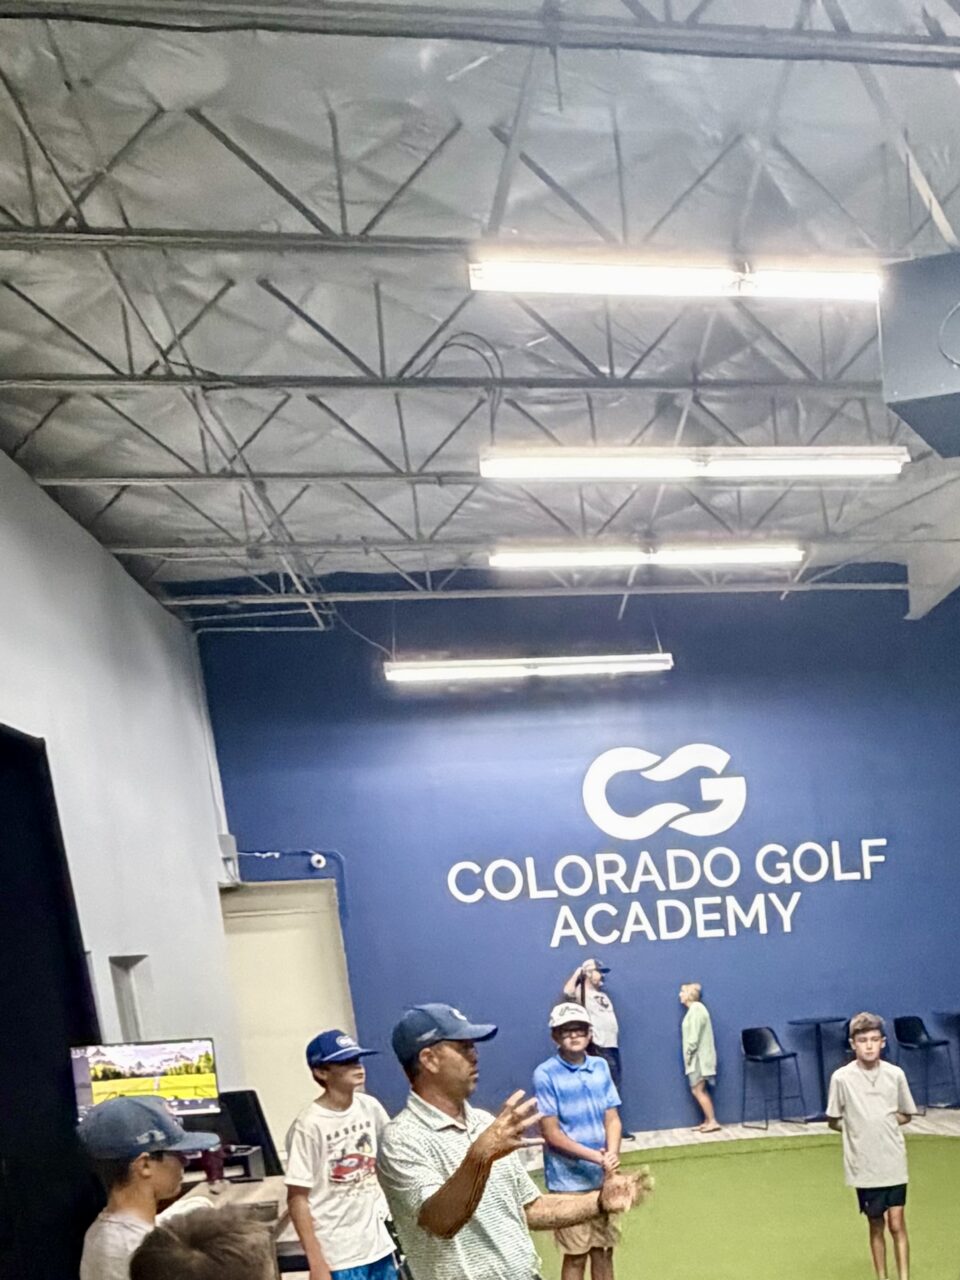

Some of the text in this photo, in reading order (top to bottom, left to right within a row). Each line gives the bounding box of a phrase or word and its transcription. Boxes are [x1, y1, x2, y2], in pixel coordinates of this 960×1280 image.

[446, 838, 887, 904] COLORADO GOLF
[550, 891, 802, 948] ACADEMY
